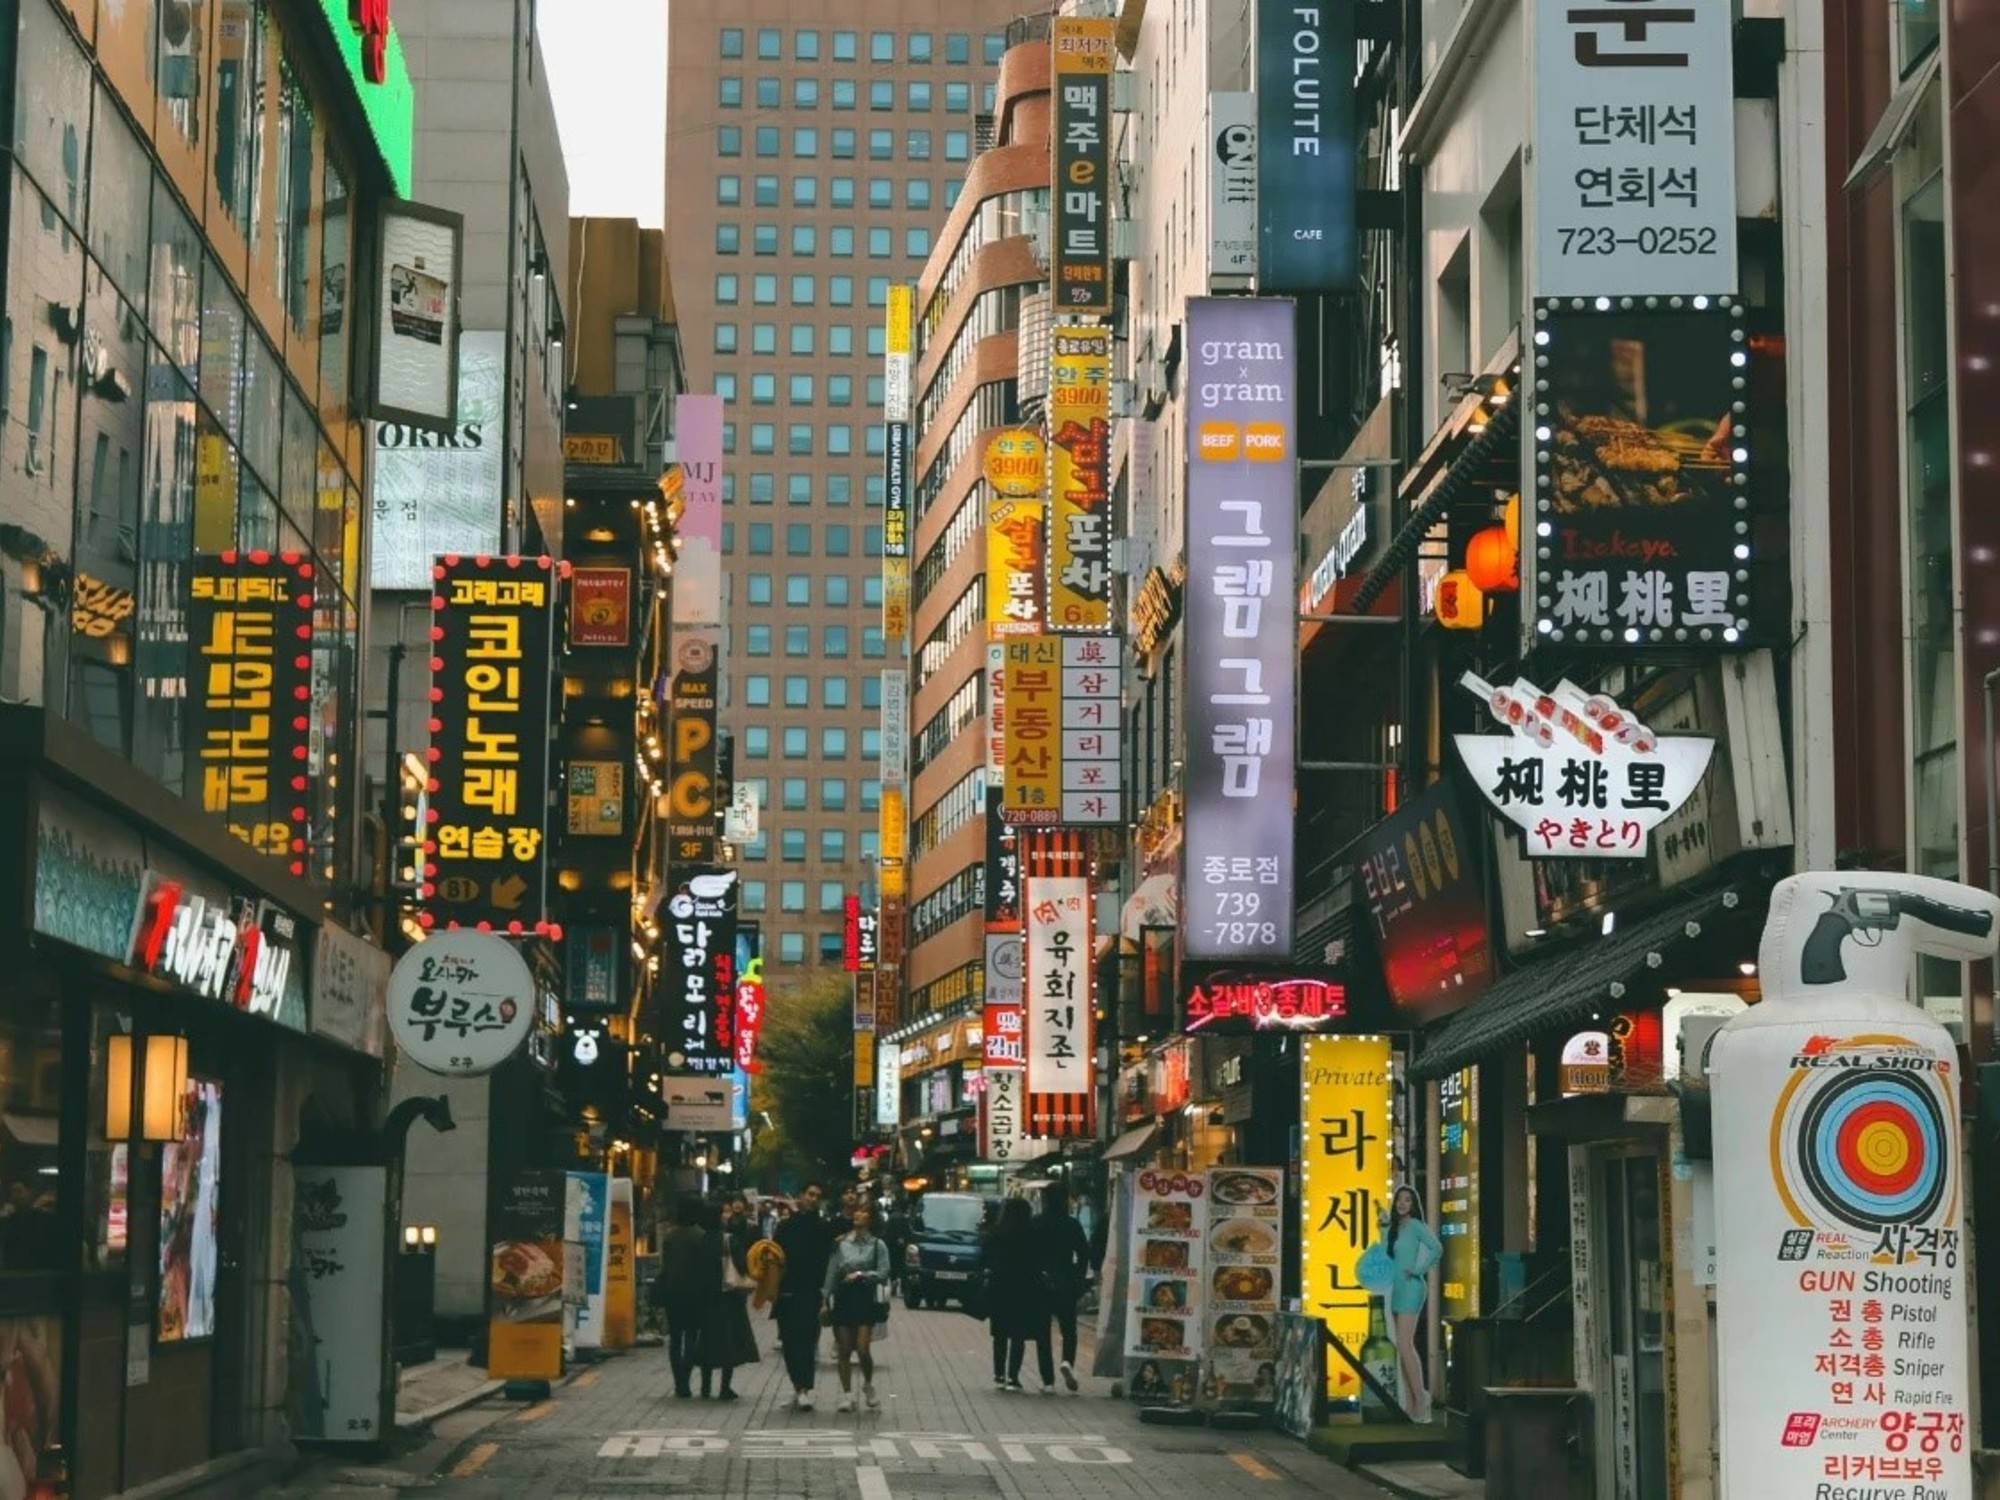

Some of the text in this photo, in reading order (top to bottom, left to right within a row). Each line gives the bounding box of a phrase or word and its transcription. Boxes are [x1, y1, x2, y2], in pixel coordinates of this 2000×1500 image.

[1059, 38, 1108, 53] 최저가
[1574, 104, 1697, 145] 단체석
[1574, 166, 1698, 207] 연회석
[1294, 230, 1322, 240] CAFE
[1557, 226, 1717, 256] 723-0252
[1201, 341, 1283, 365] gram
[1201, 381, 1284, 408] gram
[1202, 434, 1234, 446] BEEF
[1245, 434, 1281, 446] PORK
[450, 579, 545, 607] 고래고래
[680, 683, 707, 694] MAX
[465, 615, 522, 816] 코인노래
[674, 698, 714, 709] SPEED
[1010, 669, 1053, 779] 부동산
[437, 824, 542, 862] 연습장
[1534, 817, 1642, 851] やきとり
[680, 843, 703, 858] 3F
[1202, 856, 1279, 885] 종로점
[1215, 892, 1260, 916] 739
[1203, 922, 1277, 945] -7878
[1044, 930, 1076, 1069] 육회지존
[407, 985, 506, 1042] 부루스
[1790, 1054, 1938, 1072] REAL SHOT
[1313, 1066, 1387, 1087] Private
[1318, 1108, 1377, 1310] 라세느
[1816, 1232, 1849, 1243] REAL
[1872, 1226, 1960, 1269] 사격장
[1816, 1249, 1869, 1261] Reaction
[1799, 1270, 1952, 1300] GUN Shooting
[1890, 1303, 1937, 1323] Pistol
[1898, 1331, 1936, 1350] Rifle
[1815, 1353, 1945, 1380] 저격총 Sniper
[1894, 1390, 1932, 1406] Rapid
[1935, 1391, 1953, 1405] Fire
[1820, 1429, 1858, 1440] Center
[1821, 1417, 1878, 1429] ARCHERY
[1879, 1411, 1964, 1453] 양궁장
[1823, 1455, 1943, 1482] 리커브보우
[1816, 1483, 1947, 1500] Recurve Bow
